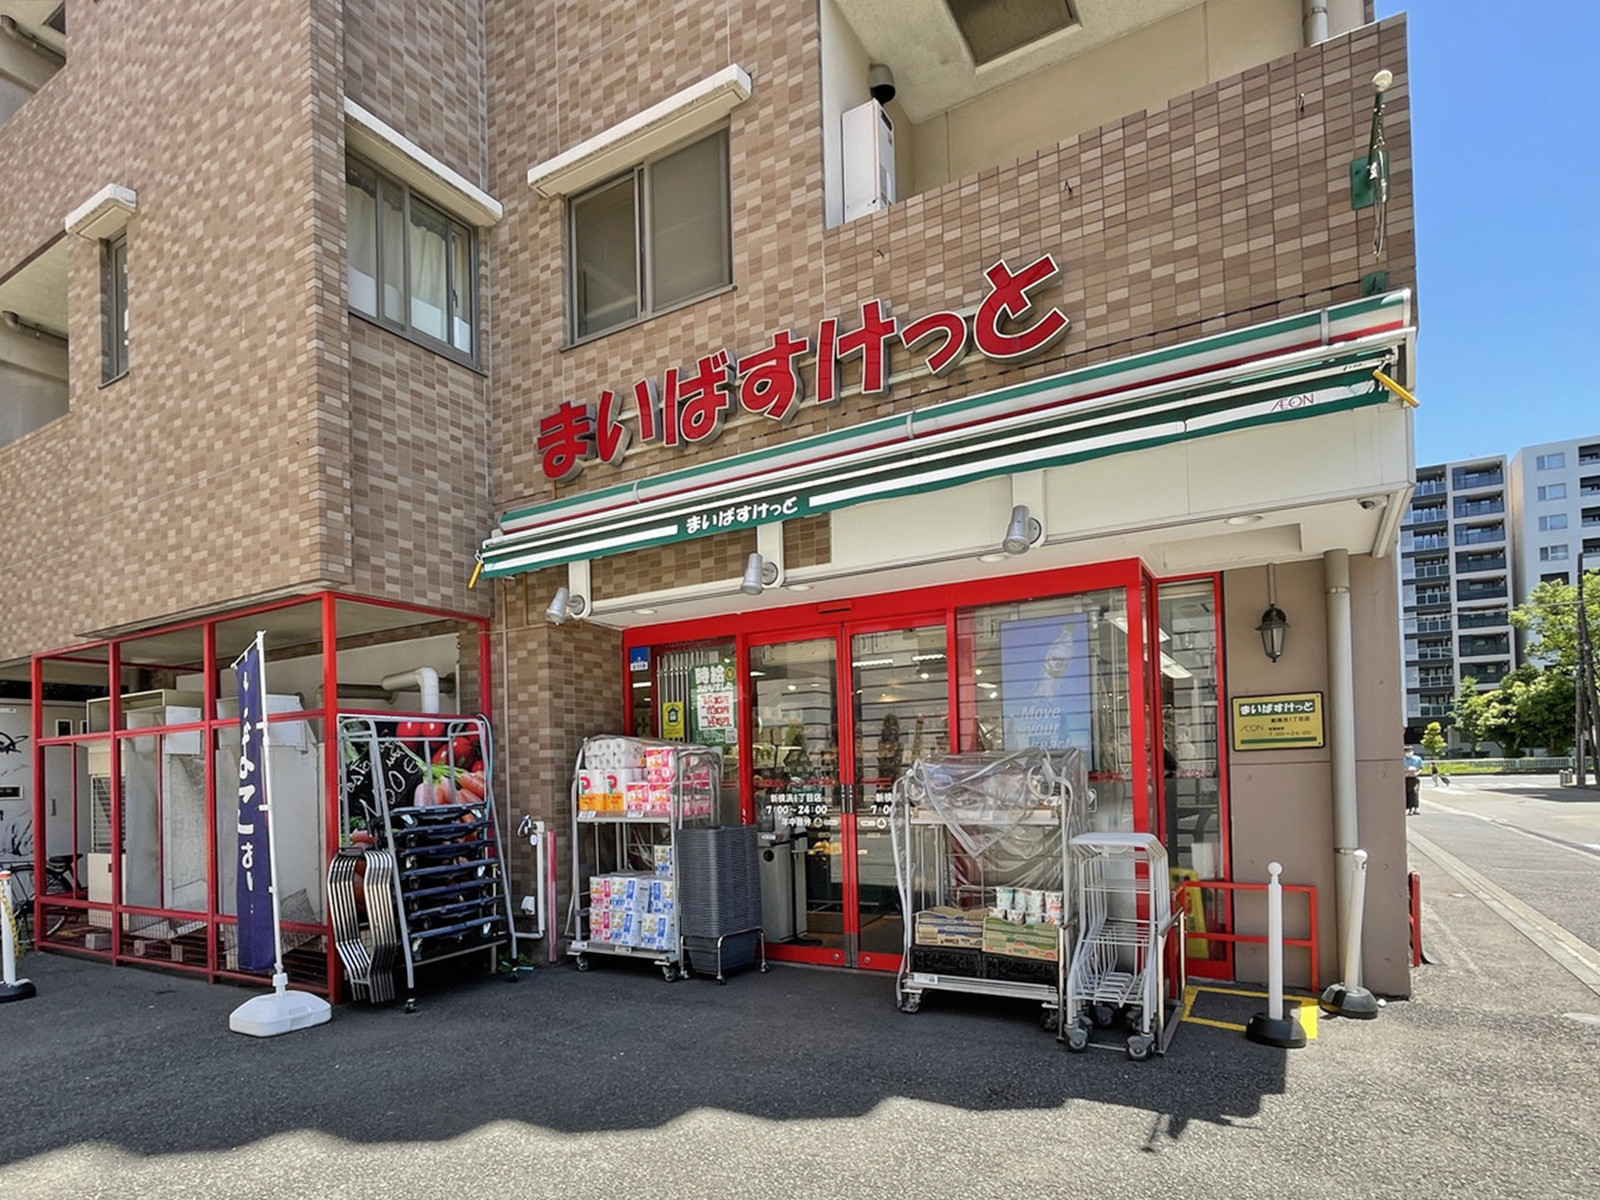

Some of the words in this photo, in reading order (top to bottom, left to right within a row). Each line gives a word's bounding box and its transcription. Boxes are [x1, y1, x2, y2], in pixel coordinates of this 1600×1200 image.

[536, 252, 1071, 482] まいばすけっと
[686, 496, 798, 534] まいばすけっと
[1020, 705, 1061, 720] Move
[1240, 701, 1314, 715] まいばすけっと
[1027, 723, 1060, 736] your
